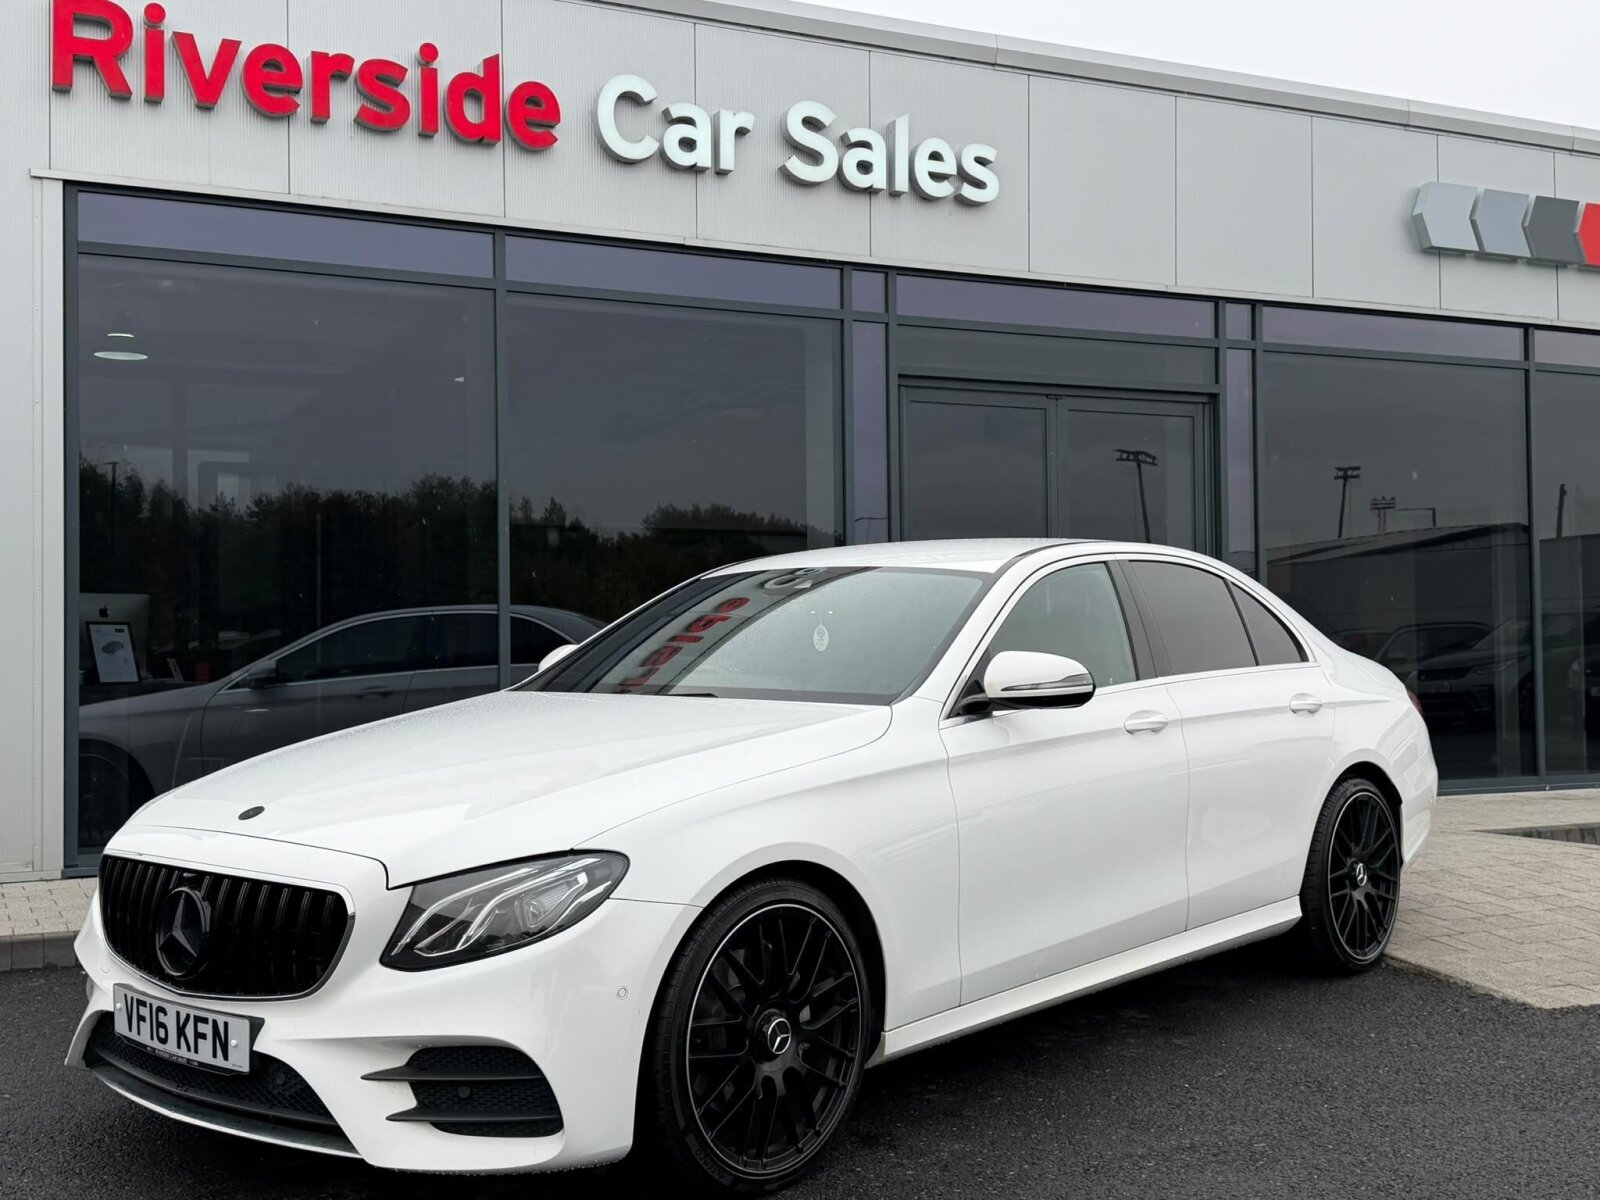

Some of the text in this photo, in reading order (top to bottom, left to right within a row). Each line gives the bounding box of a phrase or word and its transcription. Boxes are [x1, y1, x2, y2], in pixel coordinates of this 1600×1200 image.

[52, 0, 1000, 206] Riverside Car Sales
[124, 994, 228, 1061] VF16 KFN
